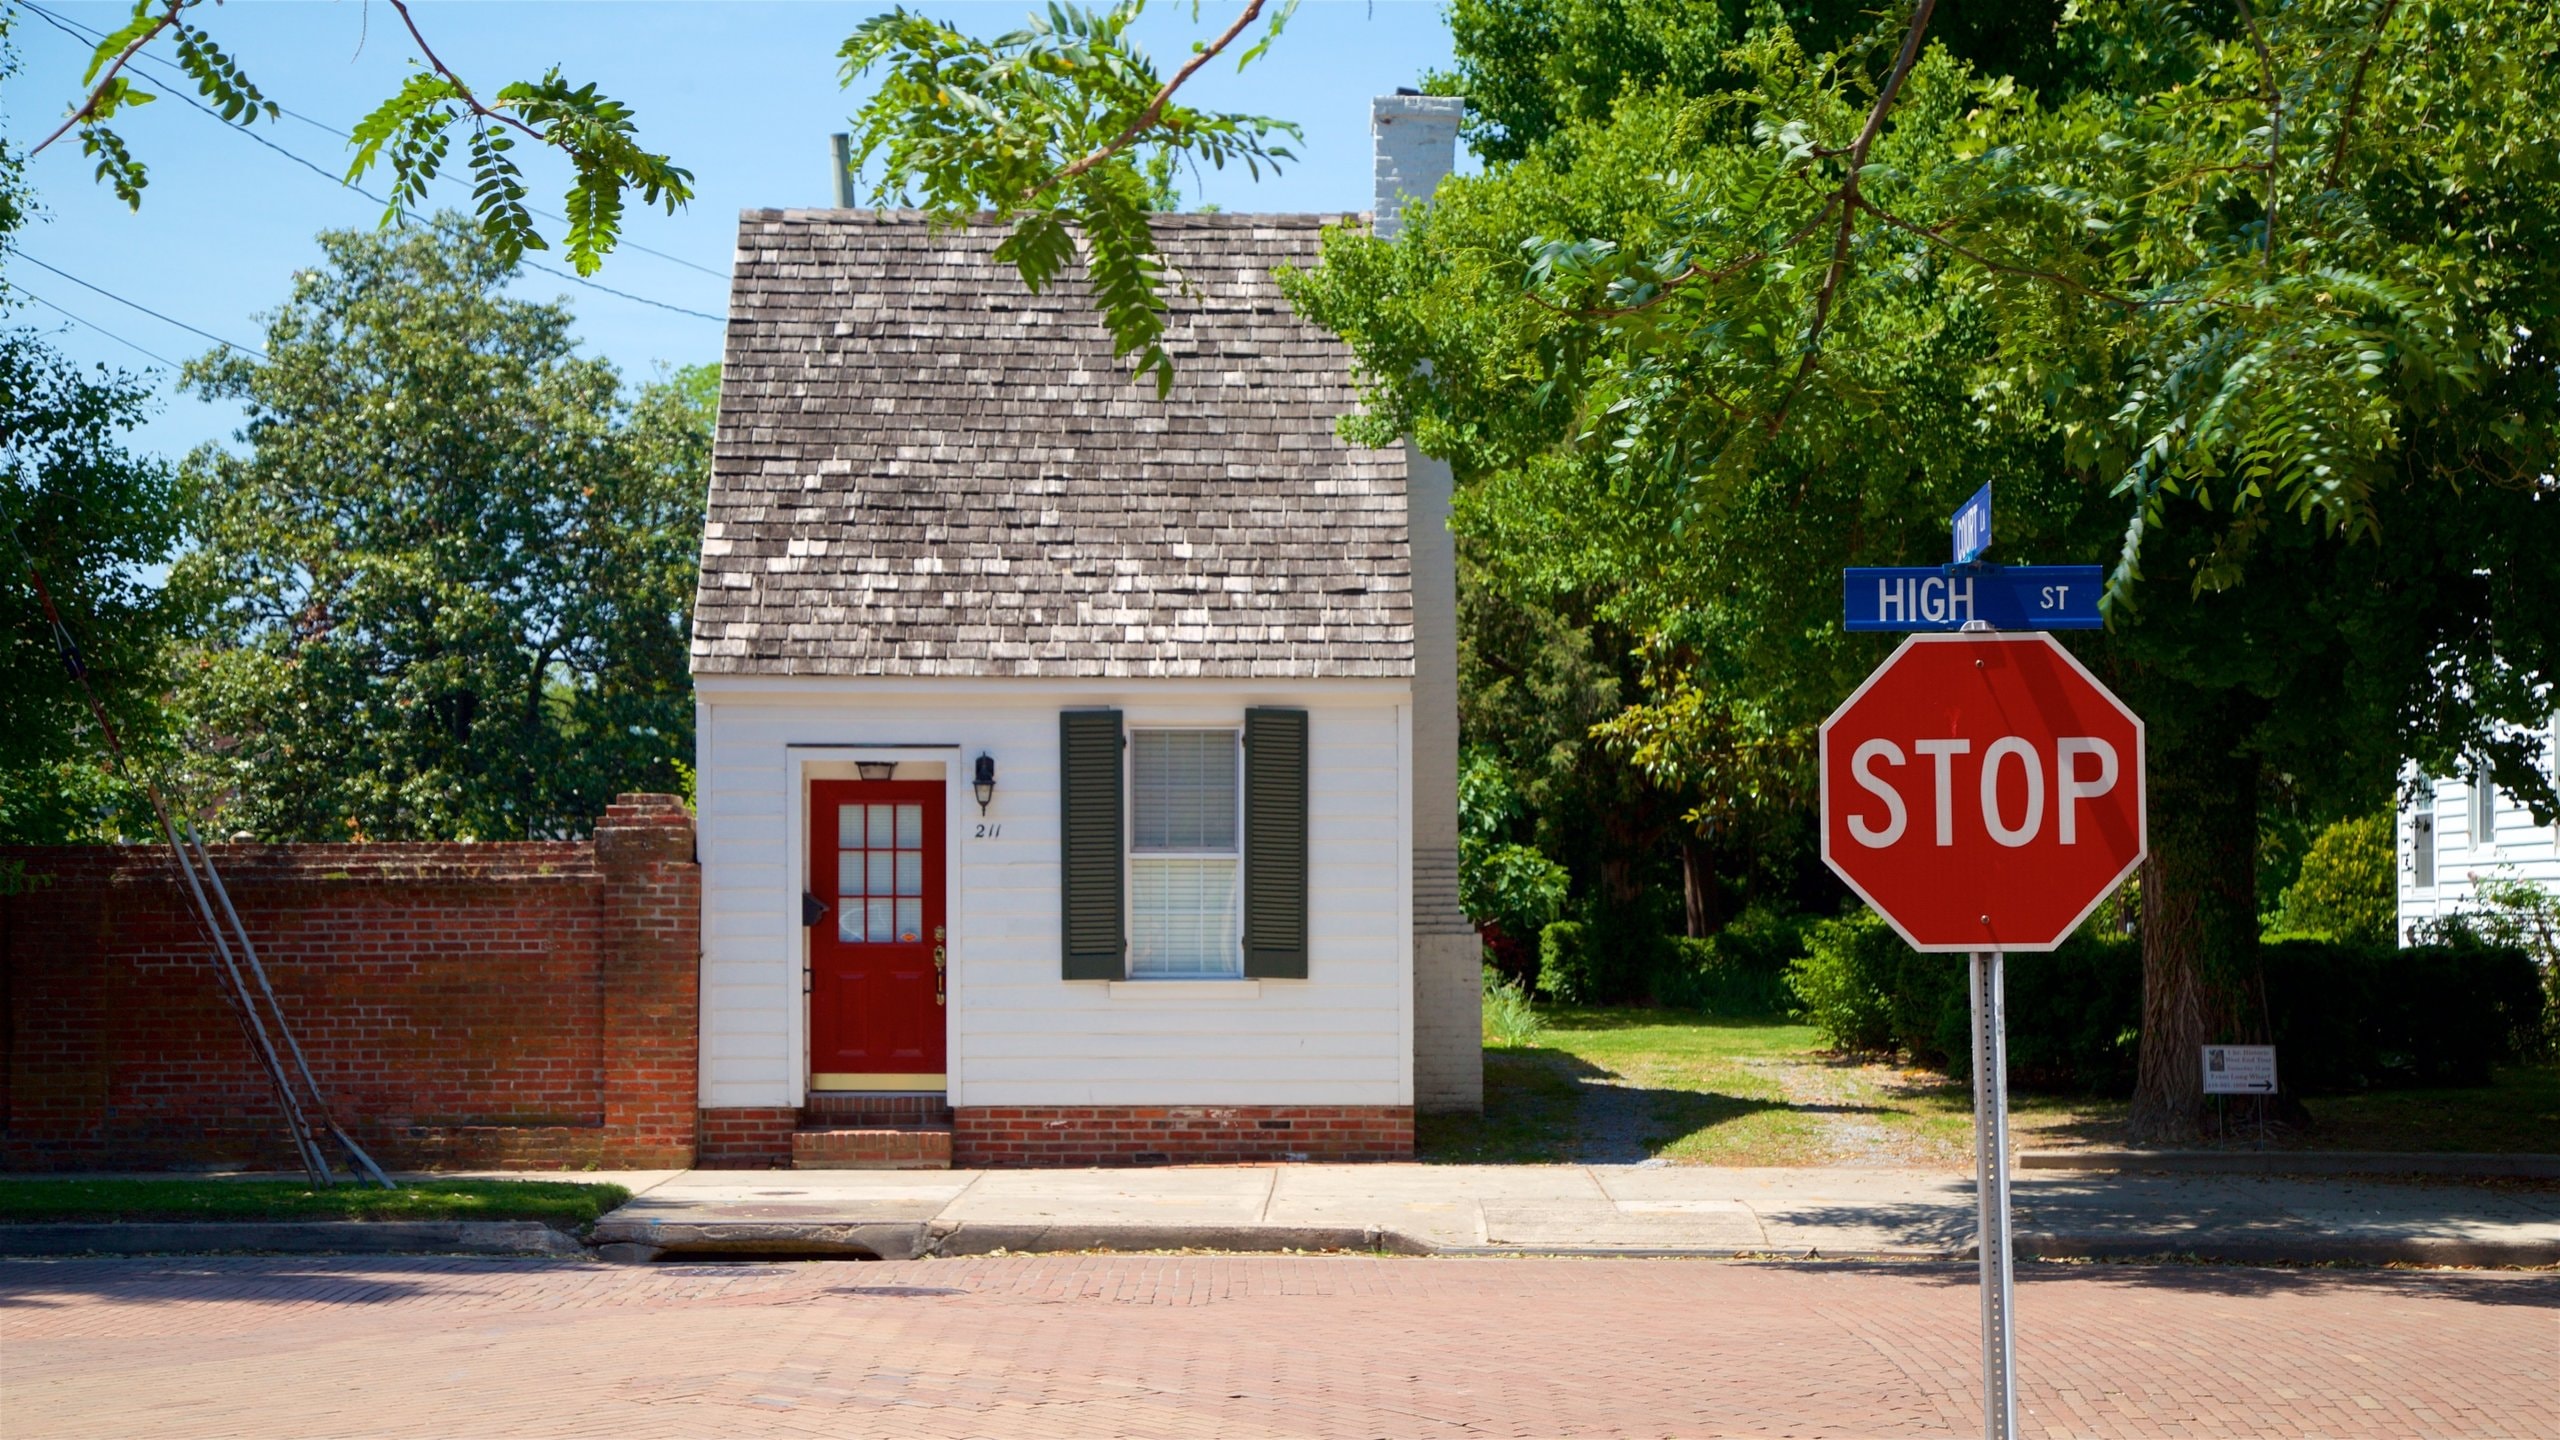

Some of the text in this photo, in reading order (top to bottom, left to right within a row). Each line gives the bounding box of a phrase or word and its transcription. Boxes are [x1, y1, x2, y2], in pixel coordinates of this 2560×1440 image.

[1957, 503, 1978, 562] COURT
[1879, 577, 2069, 622] HIGH ST
[1847, 736, 2119, 848] STOP
[974, 824, 1001, 838] 211
